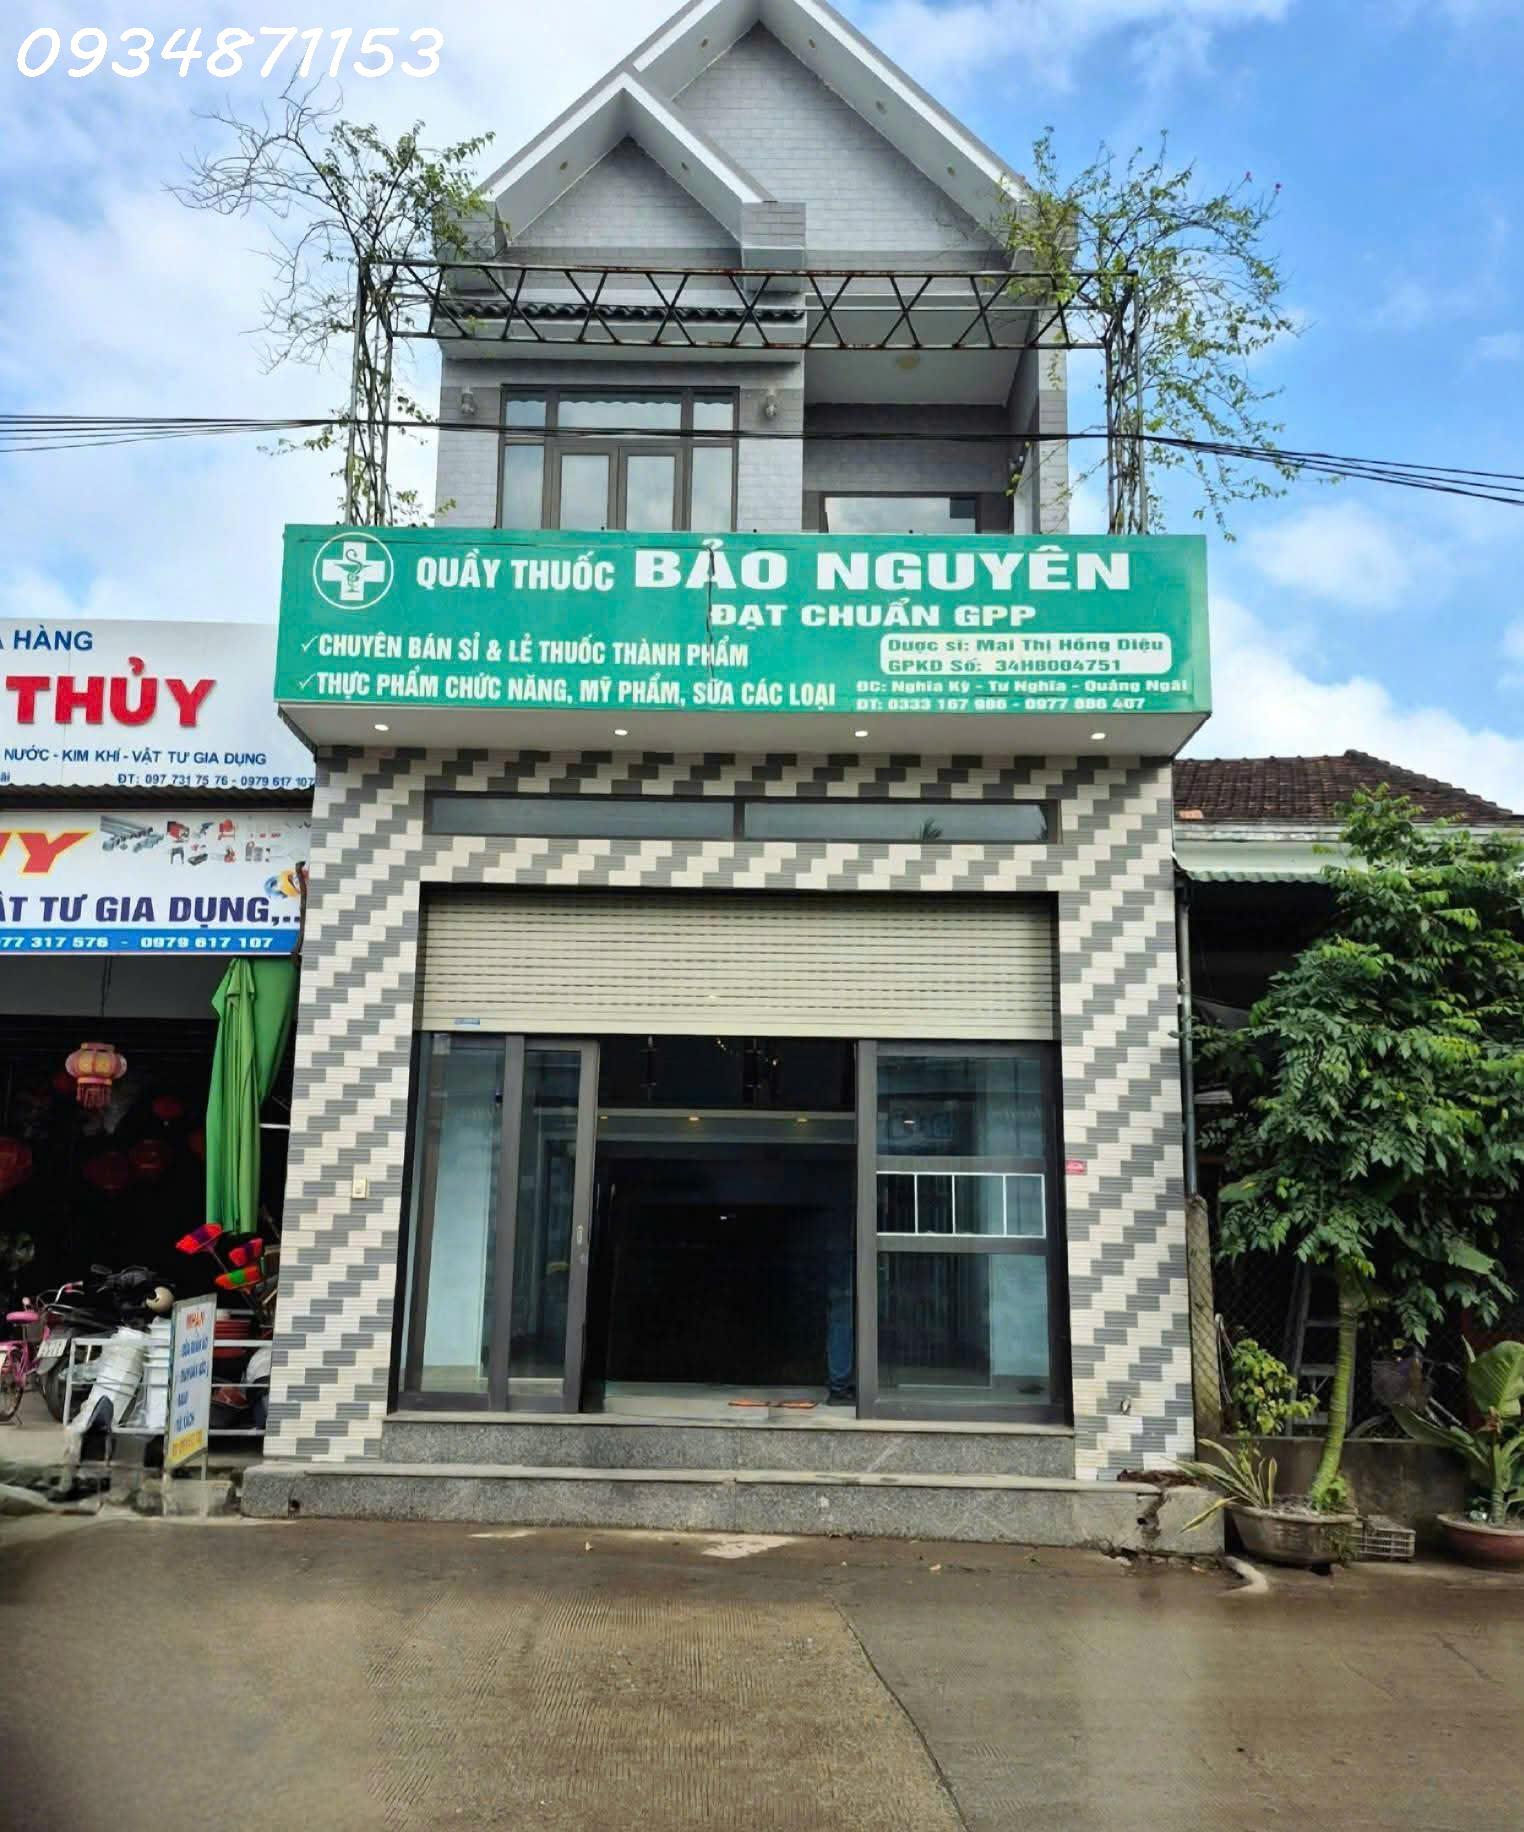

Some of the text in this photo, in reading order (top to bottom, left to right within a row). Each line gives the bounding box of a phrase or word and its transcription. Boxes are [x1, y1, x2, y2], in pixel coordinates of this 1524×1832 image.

[416, 549, 615, 592] QUẦY THUỐC
[635, 538, 1131, 591] BẢO NGUYÊN
[710, 597, 1037, 630] ĐẠT CHUẨN GPP
[14, 624, 93, 651] HÀNG
[319, 632, 749, 667] CHUYÊN BÁN SỈ & LẺ THUỐC THÀNH PHẨM
[976, 639, 1015, 651] Mai
[1117, 638, 1163, 653] Diệu
[888, 660, 943, 672] GPKD
[6, 656, 217, 728] THỦY
[317, 670, 370, 699] THỰC
[376, 664, 439, 697] PHẨM
[446, 672, 501, 699] CHỨC
[508, 674, 573, 704] NĂNG,
[580, 676, 612, 702] MỸ
[693, 678, 735, 705] SỮA
[741, 678, 783, 705] CÁC
[789, 683, 836, 711] LOẠI
[888, 699, 931, 711] 0333
[1025, 699, 1068, 710] 0977
[4, 744, 49, 761] NƯỚC
[62, 750, 89, 762] KIM
[95, 748, 121, 762] KHÍ
[131, 747, 161, 765] VẬT
[168, 751, 190, 764] TƯ
[193, 752, 219, 764] GIA
[224, 752, 267, 767] DỤNG
[118, 774, 140, 784] ĐT:
[145, 774, 166, 784] 097
[172, 775, 191, 785] 731
[196, 776, 209, 785] 75
[215, 776, 228, 785] 76
[240, 776, 269, 786] 0979
[272, 777, 292, 786] 617
[296, 778, 314, 787] 107
[39, 894, 88, 922] TƯ
[95, 896, 155, 922] GIA
[31, 937, 66, 948] 317
[72, 937, 108, 948] 576
[140, 937, 189, 948] 0979
[238, 937, 273, 948] 107
